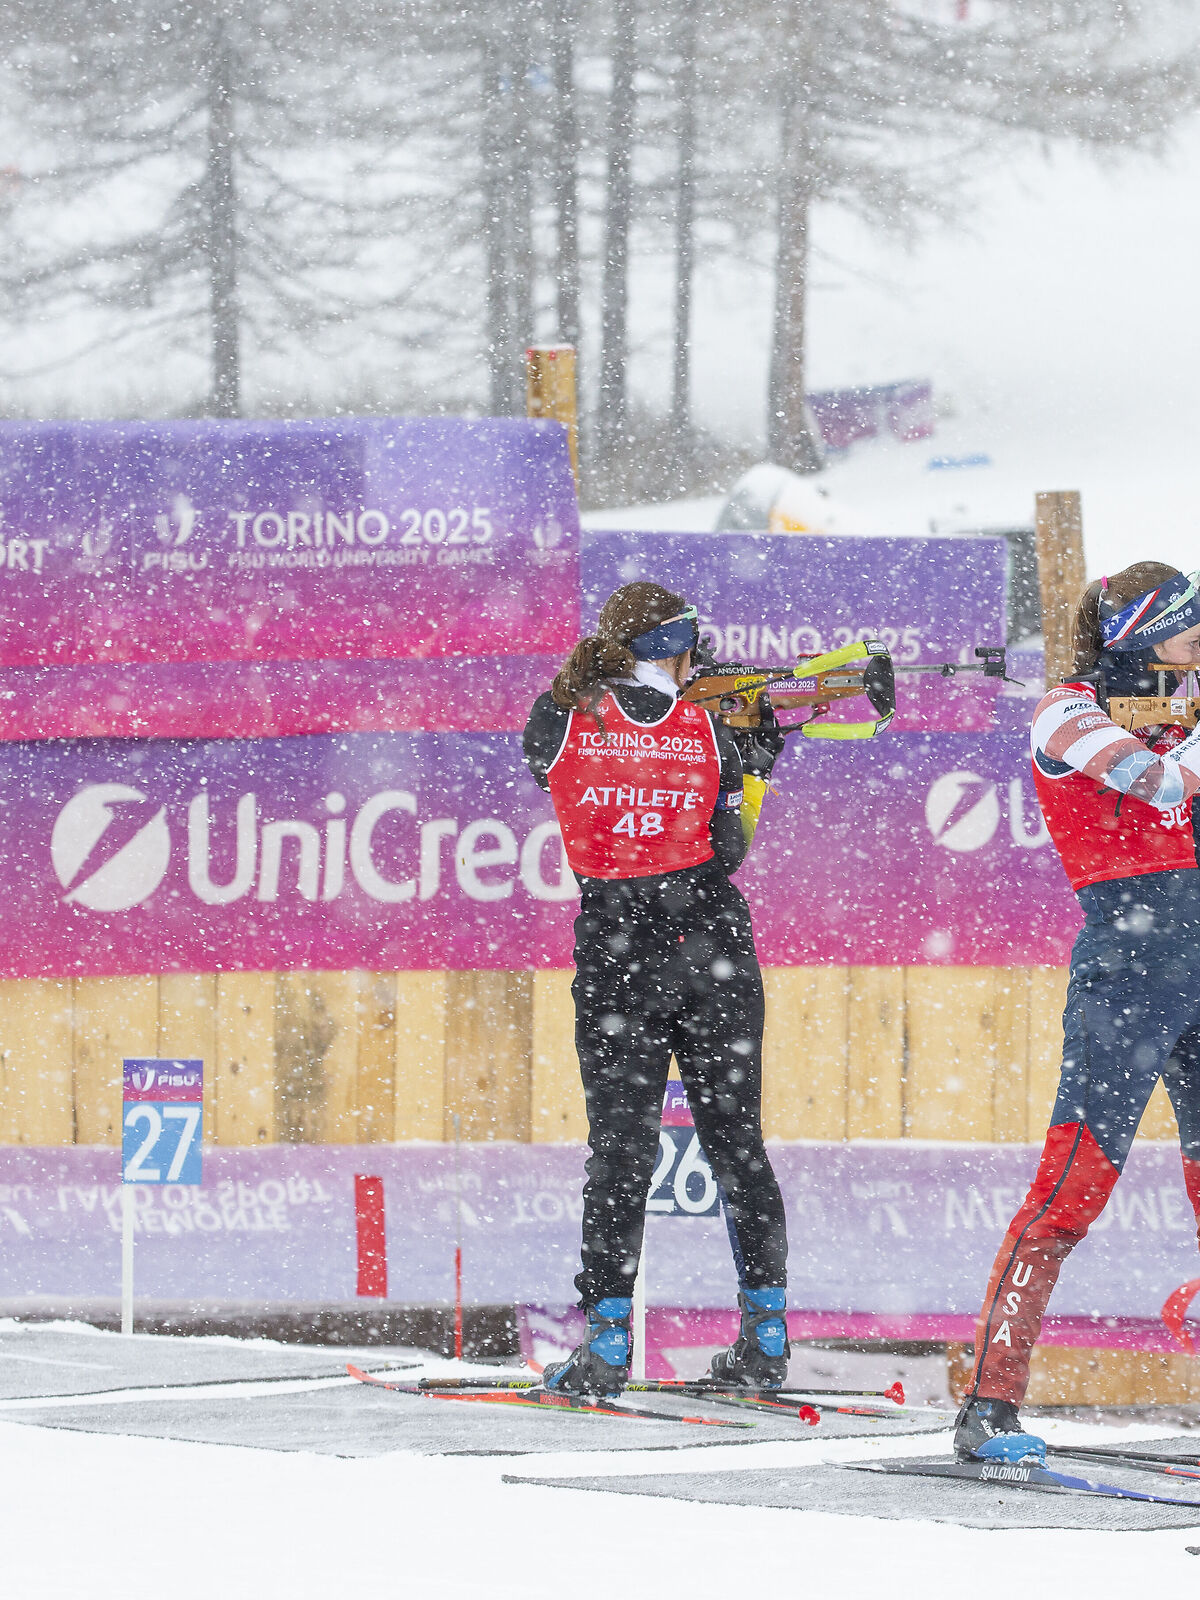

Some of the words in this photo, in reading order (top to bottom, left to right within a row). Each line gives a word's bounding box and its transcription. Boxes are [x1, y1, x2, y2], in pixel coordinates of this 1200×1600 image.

[228, 509, 389, 547] TORINO
[400, 508, 493, 545] 2025
[0, 538, 49, 571] RT
[144, 552, 207, 570] FISU
[1142, 611, 1185, 637] maloja
[697, 622, 823, 661] ORINO
[769, 681, 797, 689] TORINO
[798, 680, 816, 688] 2025
[577, 748, 595, 756] FISU
[596, 748, 629, 757] WORLD
[630, 748, 678, 761] UNIVERSITY
[678, 753, 706, 763] GAMES
[578, 732, 655, 749] TORINO
[660, 735, 703, 754] 2025
[580, 786, 699, 809] ATHLETE
[612, 812, 664, 838] 48
[187, 790, 582, 905] UniCre
[158, 1075, 195, 1086] FISU
[124, 1105, 201, 1181] 27
[645, 1131, 718, 1214] 26
[992, 1261, 1033, 1347] USA
[980, 1465, 1031, 1482] SALOMON
